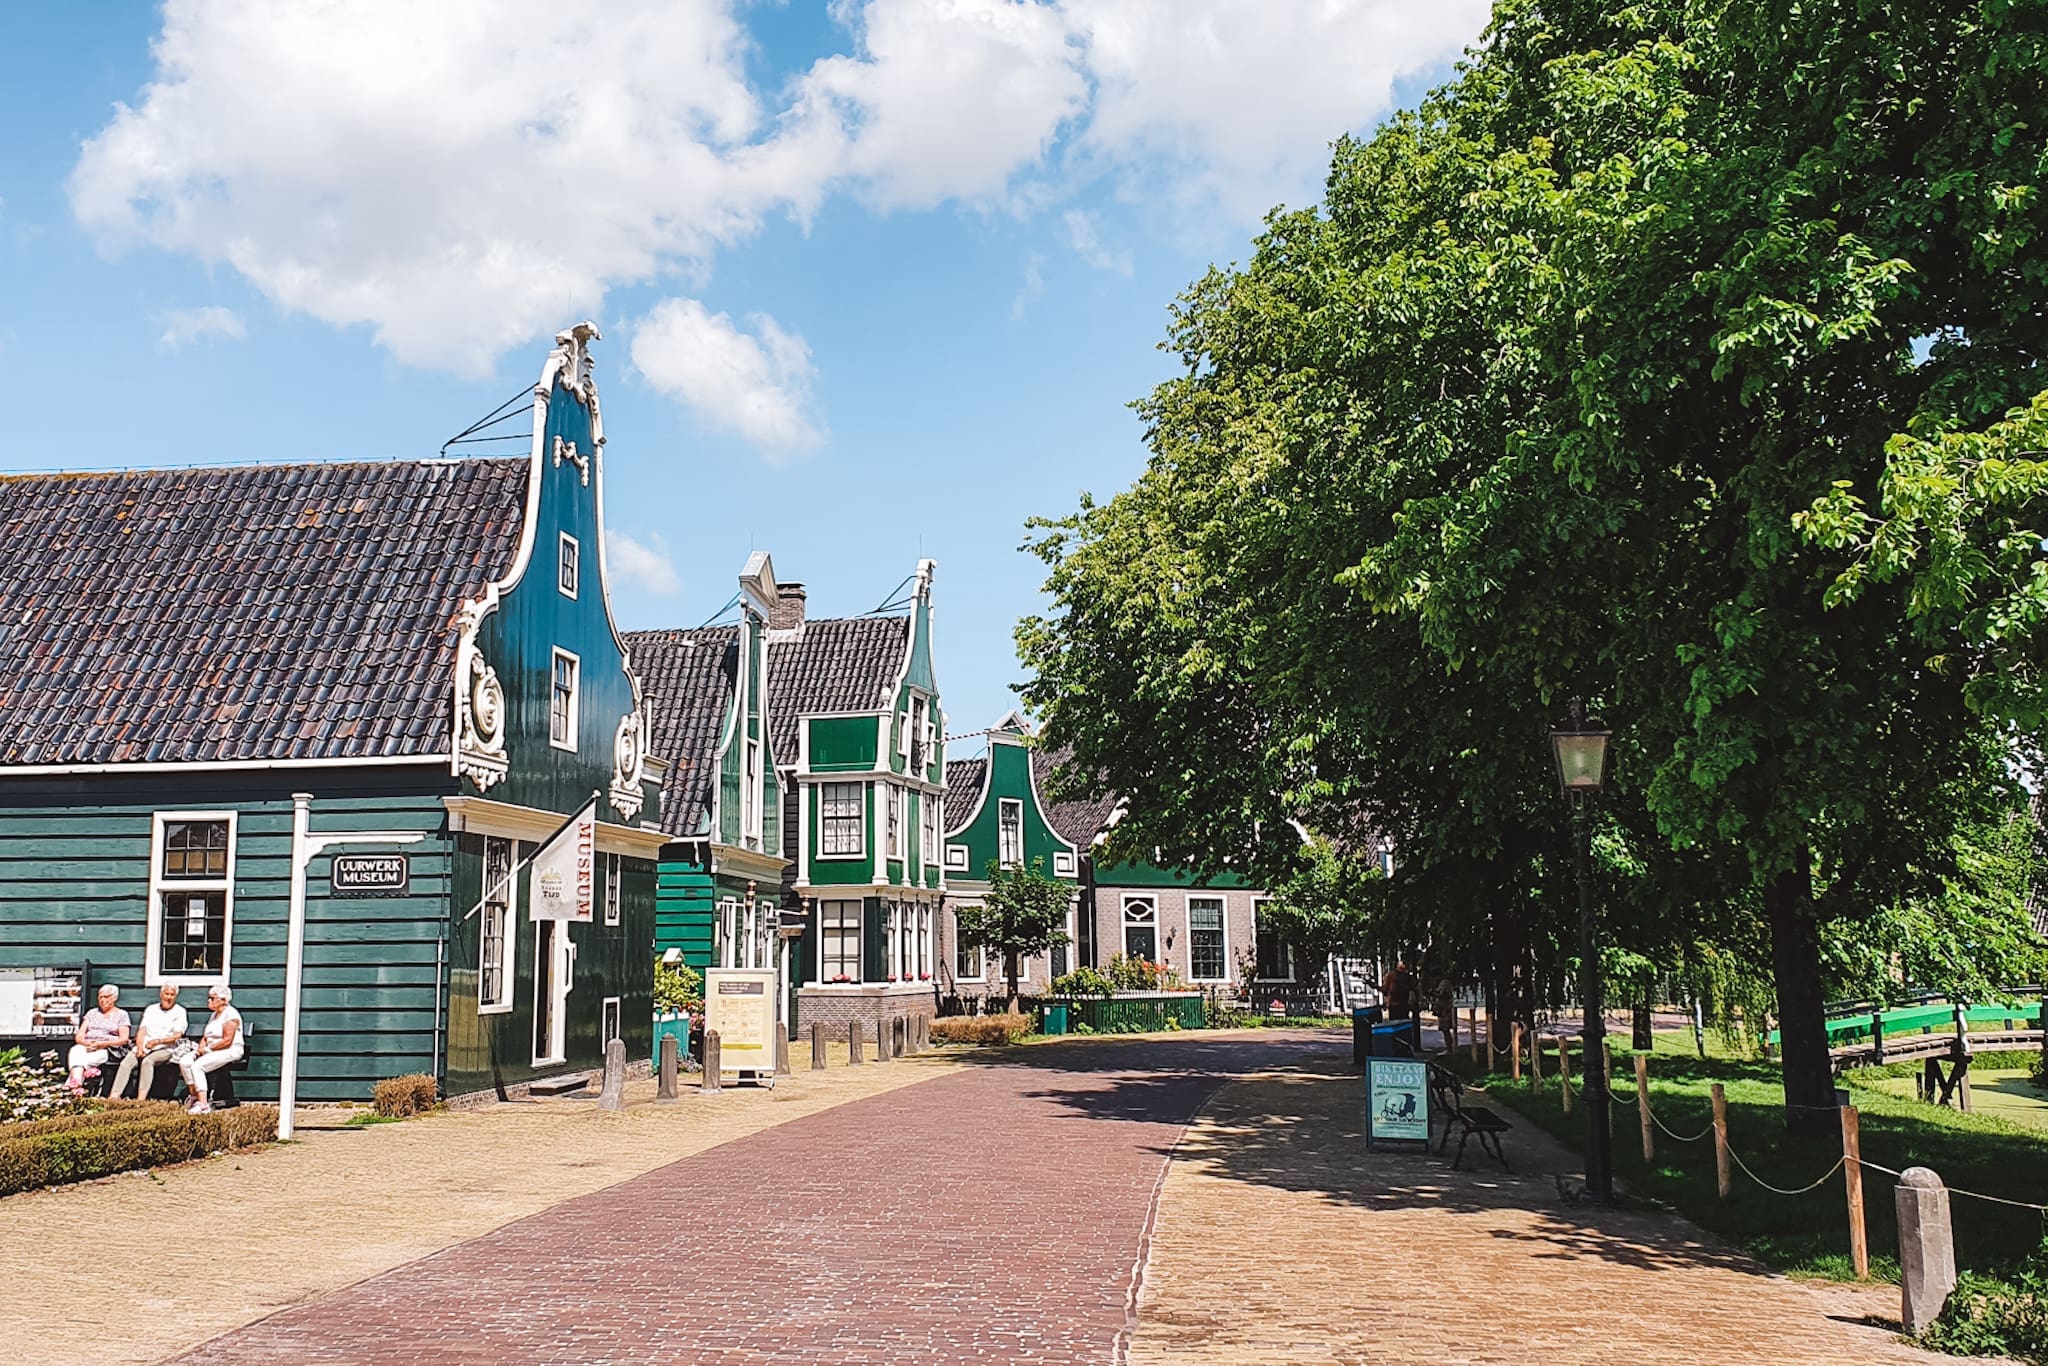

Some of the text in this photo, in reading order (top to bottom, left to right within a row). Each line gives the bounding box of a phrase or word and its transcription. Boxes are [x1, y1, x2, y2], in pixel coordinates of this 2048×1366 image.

[340, 860, 401, 871] UURWERK
[576, 822, 592, 917] MUSEUM
[343, 872, 398, 883] MUSEUM
[1375, 1073, 1424, 1085] ENJOY
